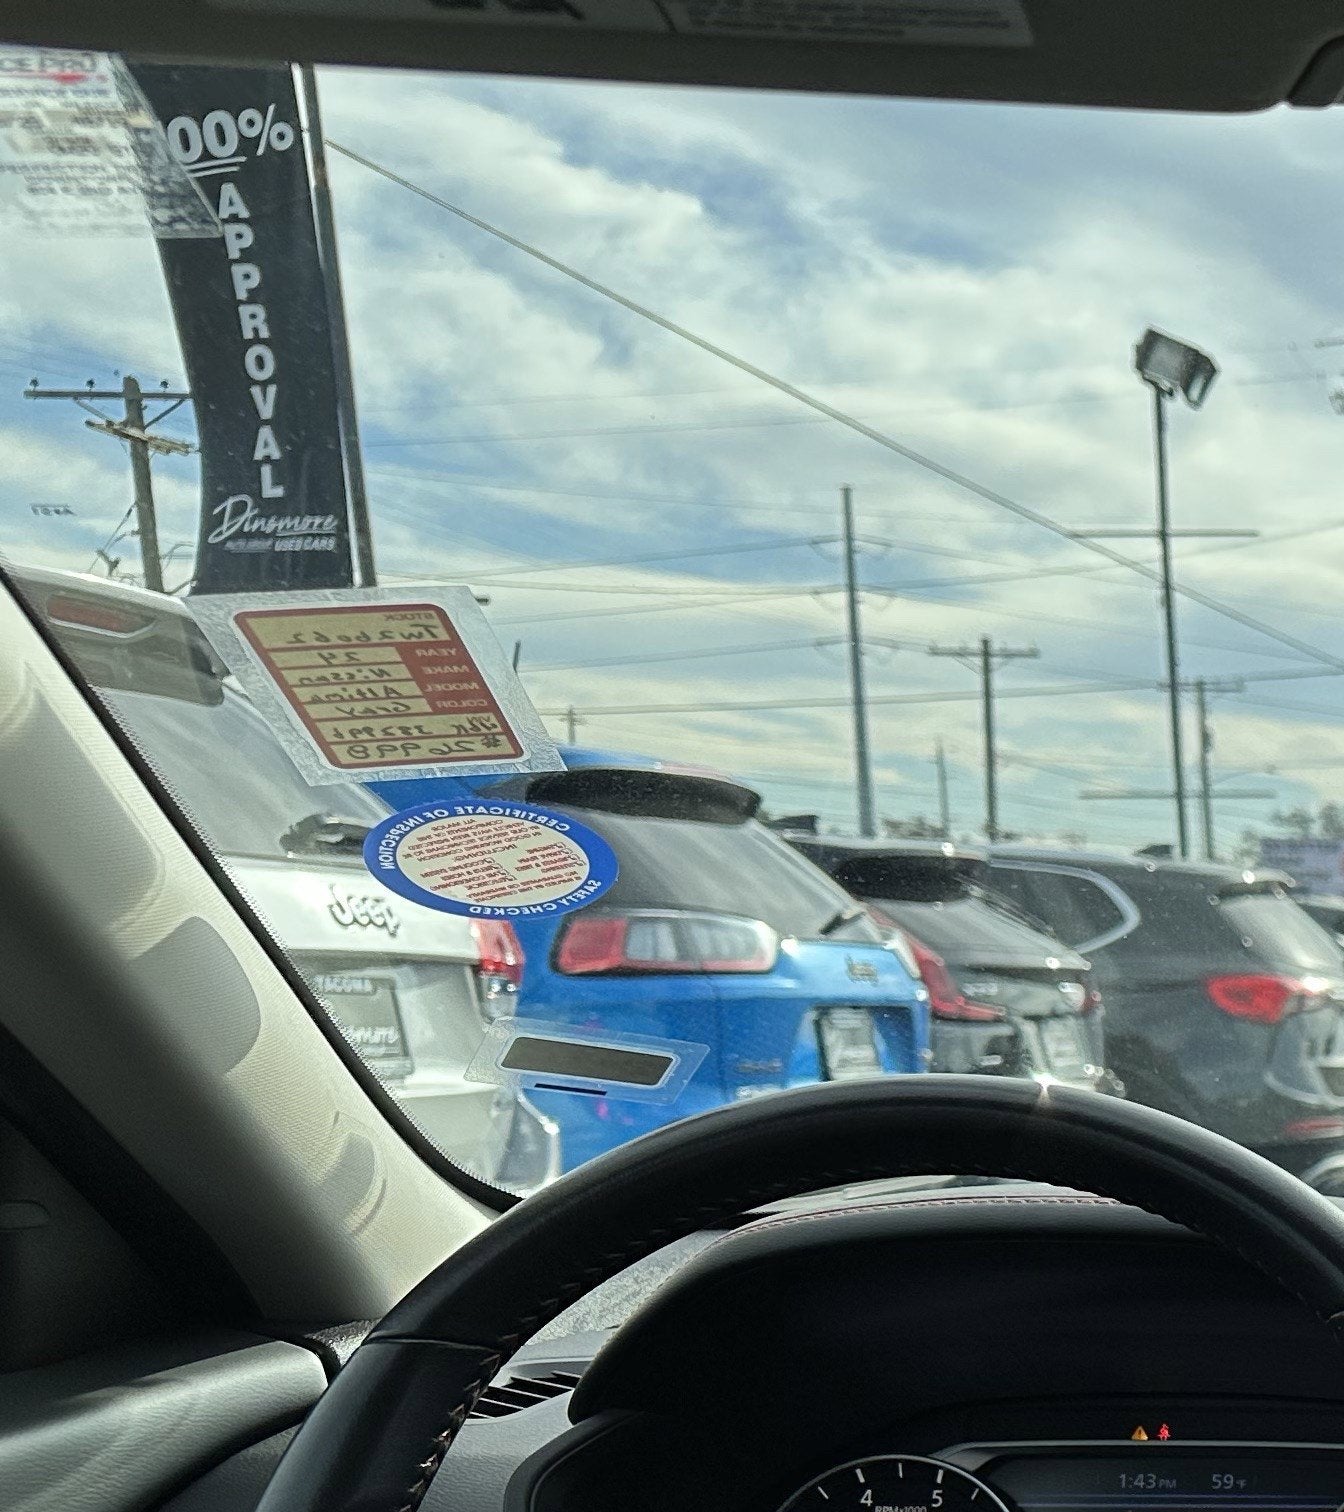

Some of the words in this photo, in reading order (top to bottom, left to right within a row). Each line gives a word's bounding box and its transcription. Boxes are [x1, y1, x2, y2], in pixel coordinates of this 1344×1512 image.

[147, 103, 294, 164] 00%
[217, 181, 285, 498] APPROVAL
[208, 494, 338, 543] Dinsmore
[302, 537, 336, 551] CARS
[327, 883, 401, 938] Jeep
[860, 1489, 874, 1508] 4
[931, 1489, 943, 1508] 5
